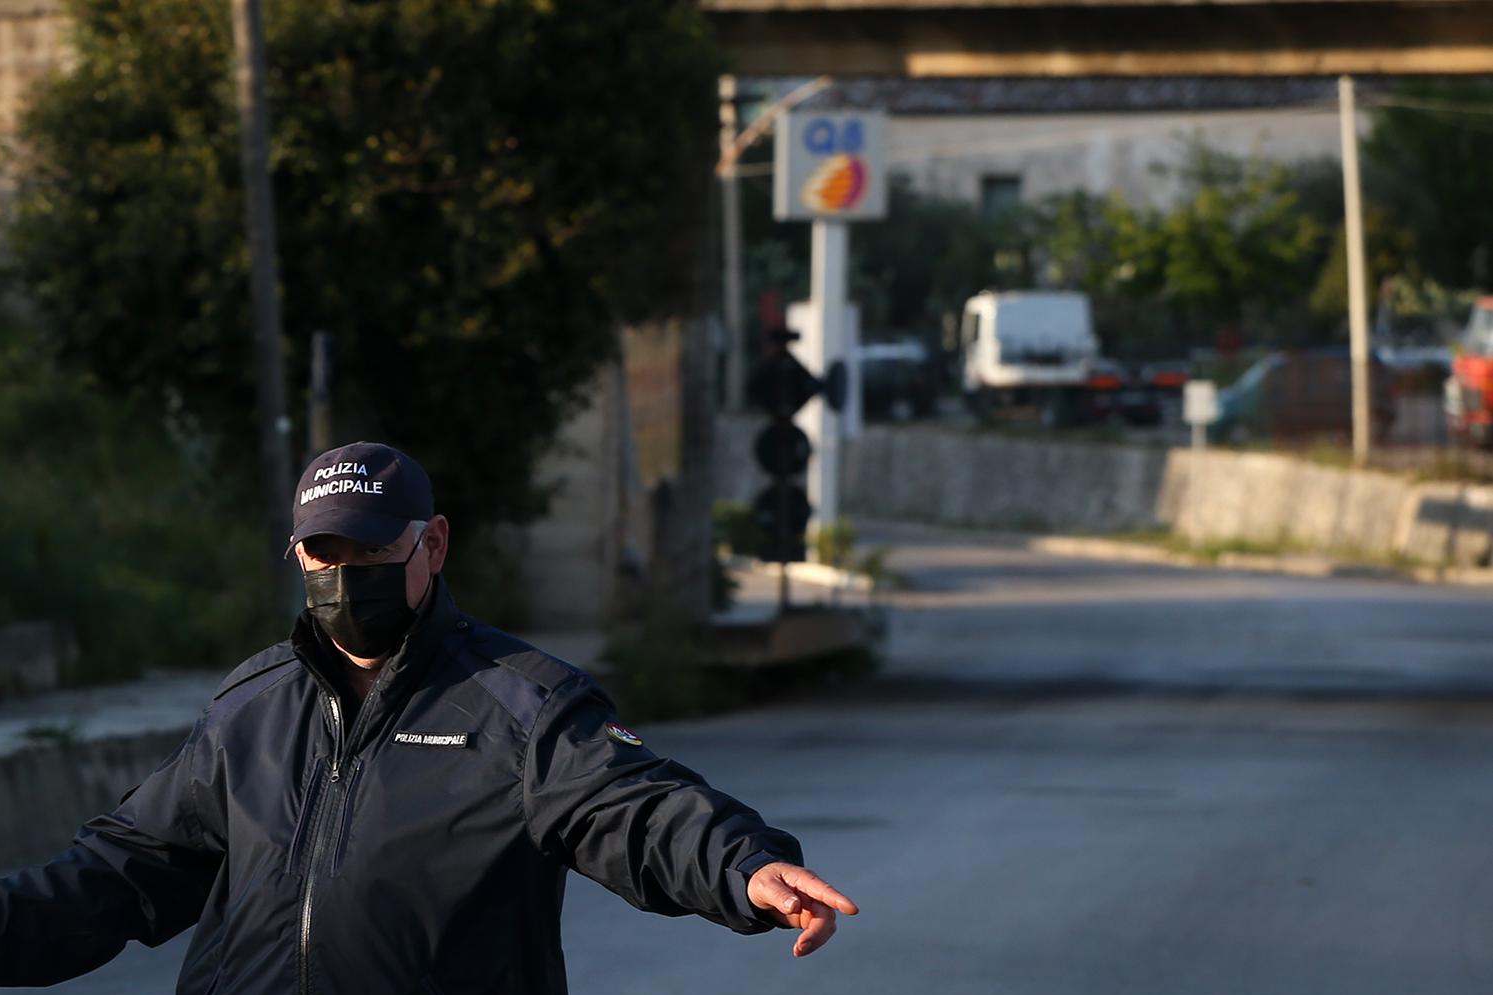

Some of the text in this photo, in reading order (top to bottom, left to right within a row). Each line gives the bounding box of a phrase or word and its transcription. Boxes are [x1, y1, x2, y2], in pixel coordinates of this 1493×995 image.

[314, 462, 368, 482] POLIZIA
[300, 479, 383, 506] MUNICIPALE
[395, 733, 466, 746] POLIZIA MUNICIPALE
